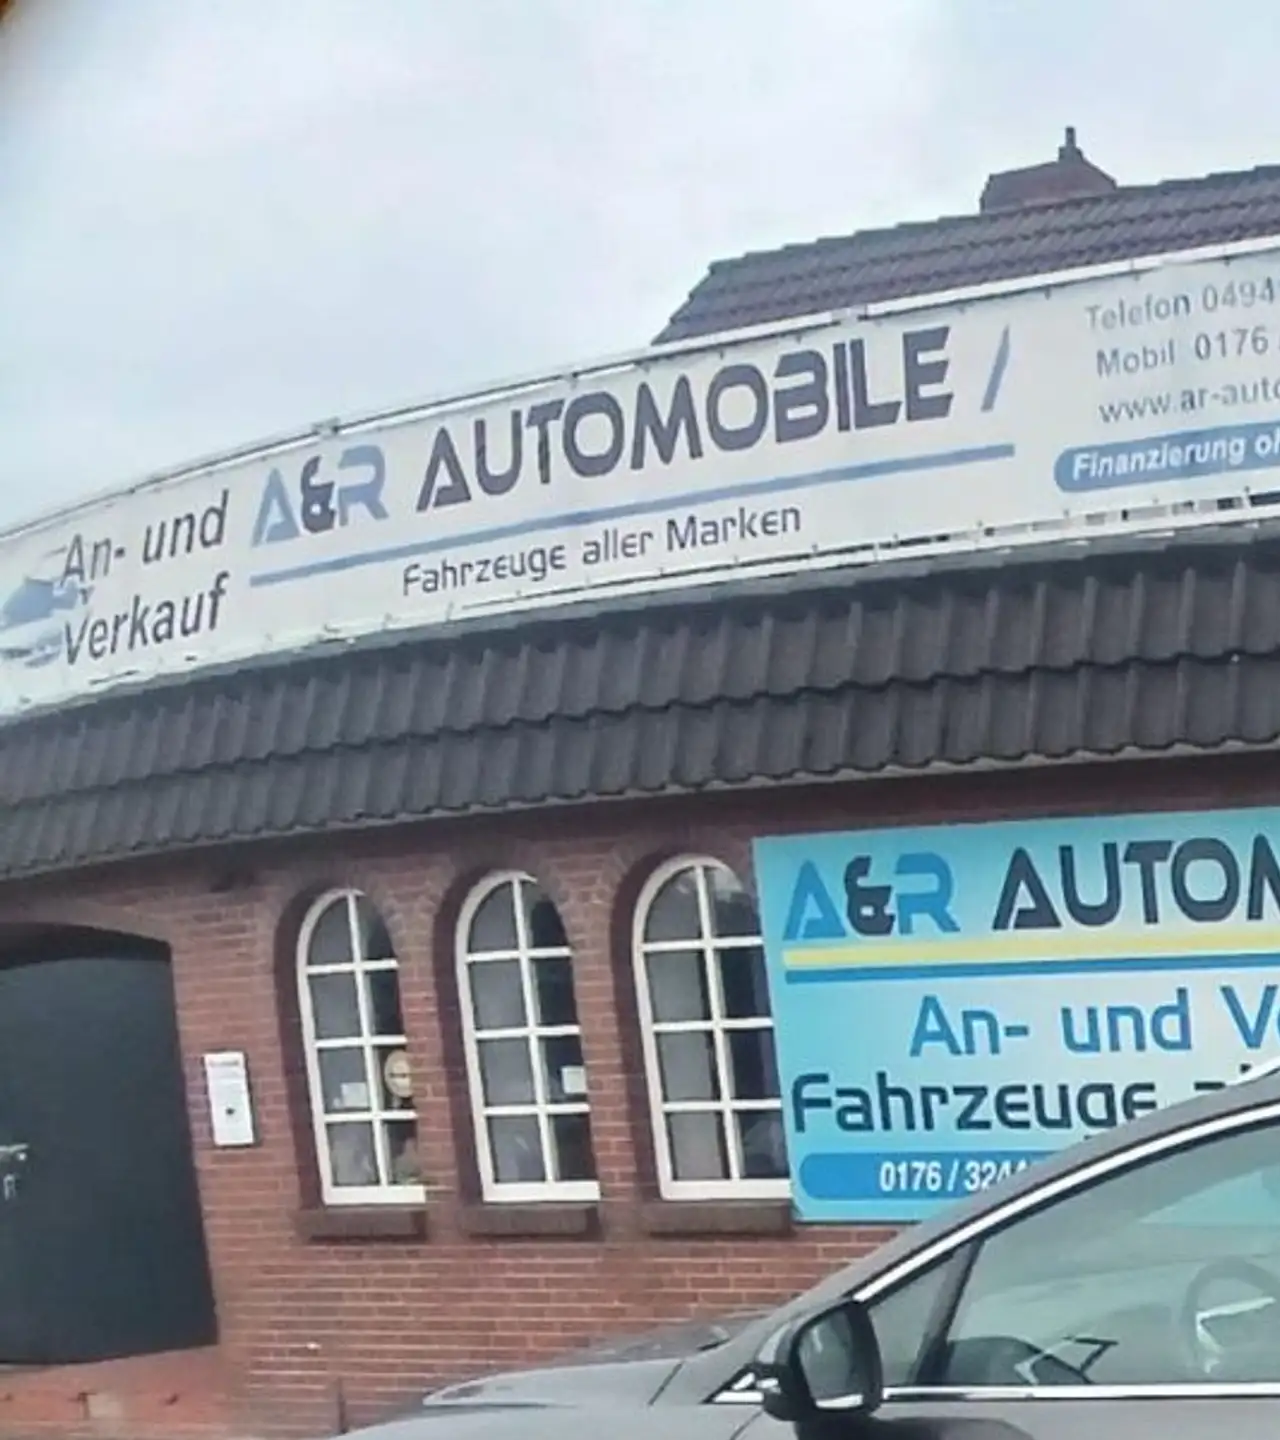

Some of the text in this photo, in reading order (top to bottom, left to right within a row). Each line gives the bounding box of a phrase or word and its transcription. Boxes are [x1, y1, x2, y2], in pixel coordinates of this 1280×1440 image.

[1085, 293, 1190, 332] Telefon
[1096, 339, 1175, 379] Mobil
[1195, 326, 1269, 360] 0176
[251, 325, 954, 548] A&R AUTOMOBILE
[1072, 435, 1246, 481] Finanzierung
[60, 489, 229, 587] An- und
[402, 505, 801, 597] Fahrzeuge aller Marken
[64, 570, 230, 665] Verkauf
[782, 851, 961, 941] A&R
[910, 995, 1029, 1057] An-
[1061, 988, 1192, 1053] und
[792, 1071, 1157, 1138] Fahrzeuge
[879, 1161, 941, 1191] 0176
